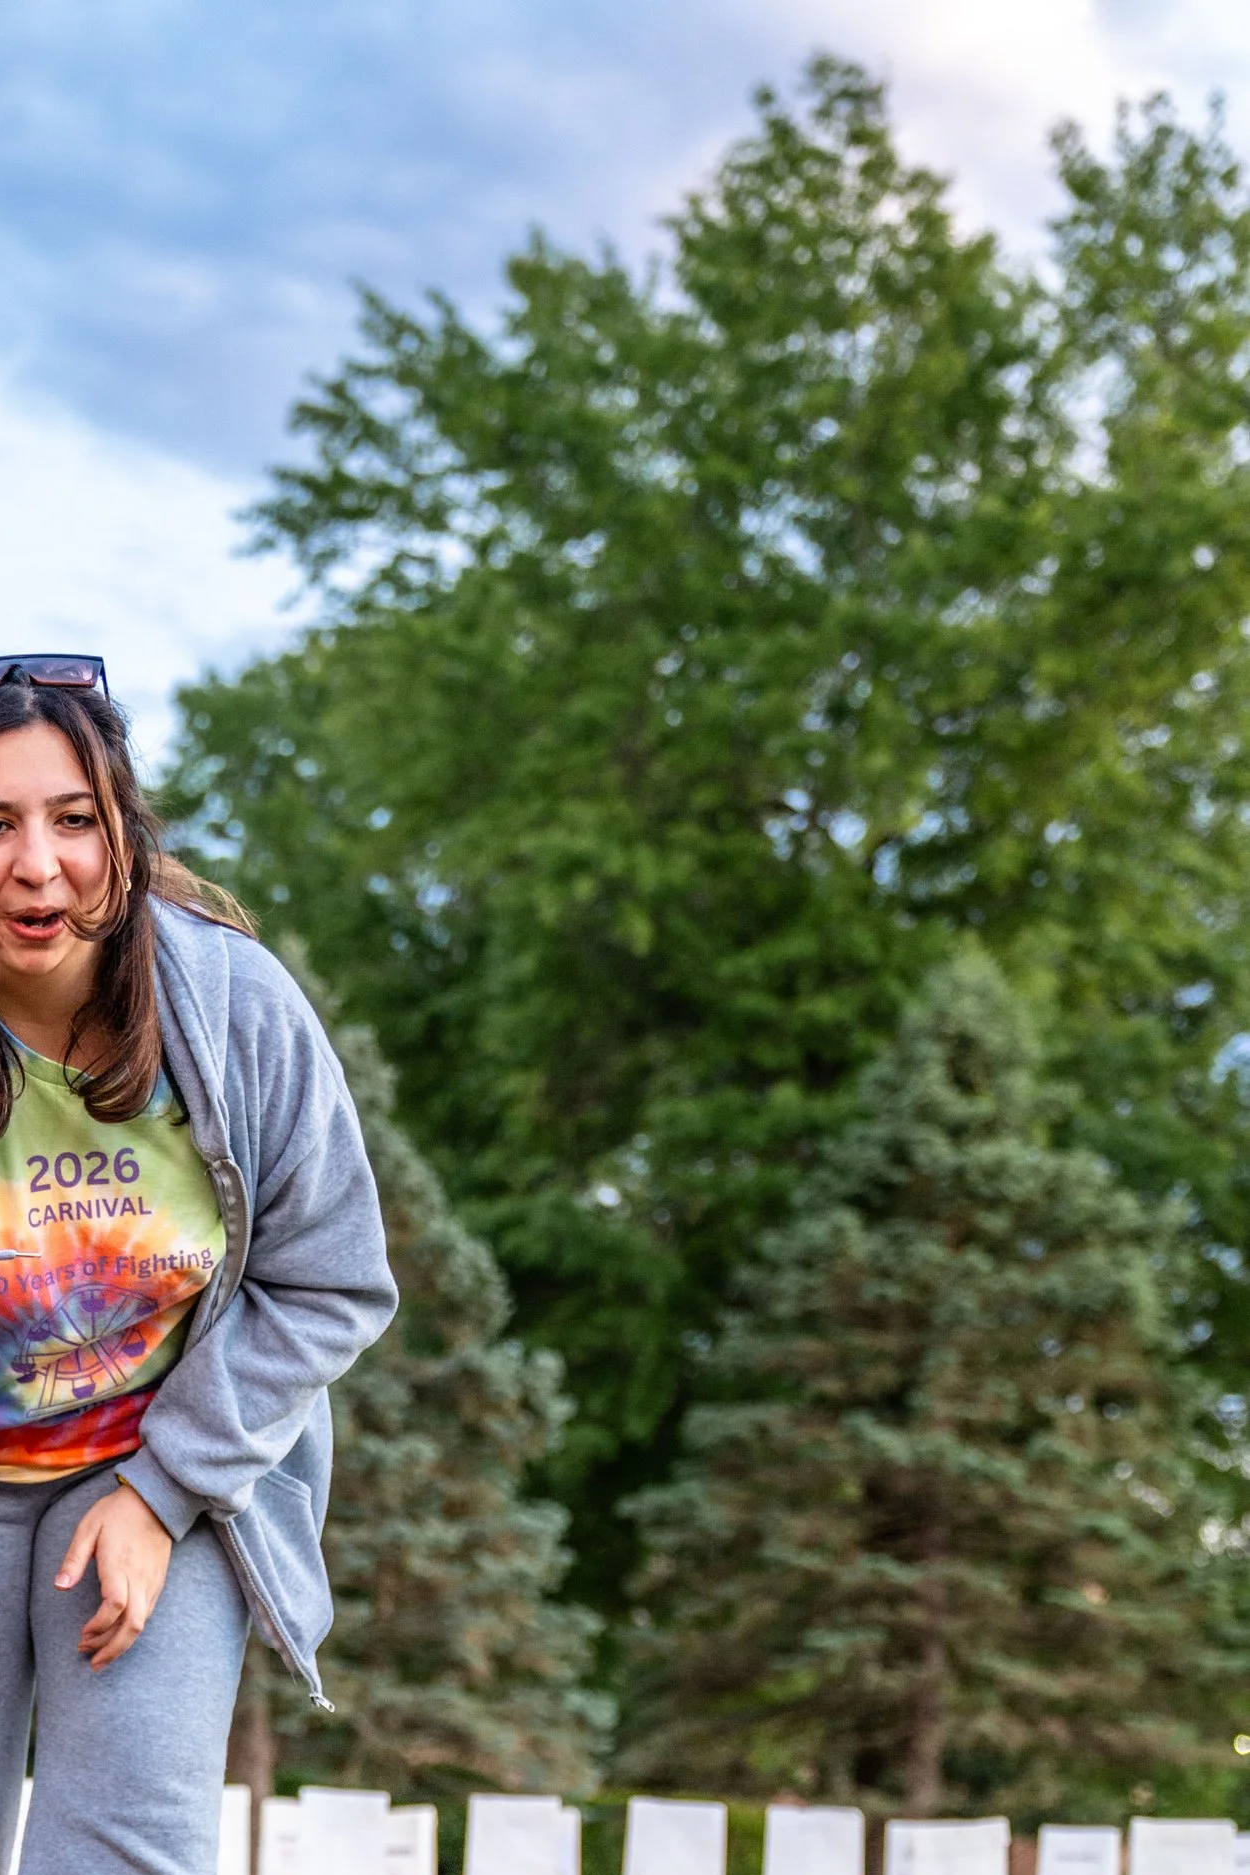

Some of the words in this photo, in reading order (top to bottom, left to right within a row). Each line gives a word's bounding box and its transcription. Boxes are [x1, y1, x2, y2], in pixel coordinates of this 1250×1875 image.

[26, 1147, 140, 1193] 2026
[28, 1196, 152, 1228] CARNIVAL
[15, 1263, 76, 1294] Years
[82, 1255, 108, 1276] of
[115, 1247, 214, 1279] Fighting
